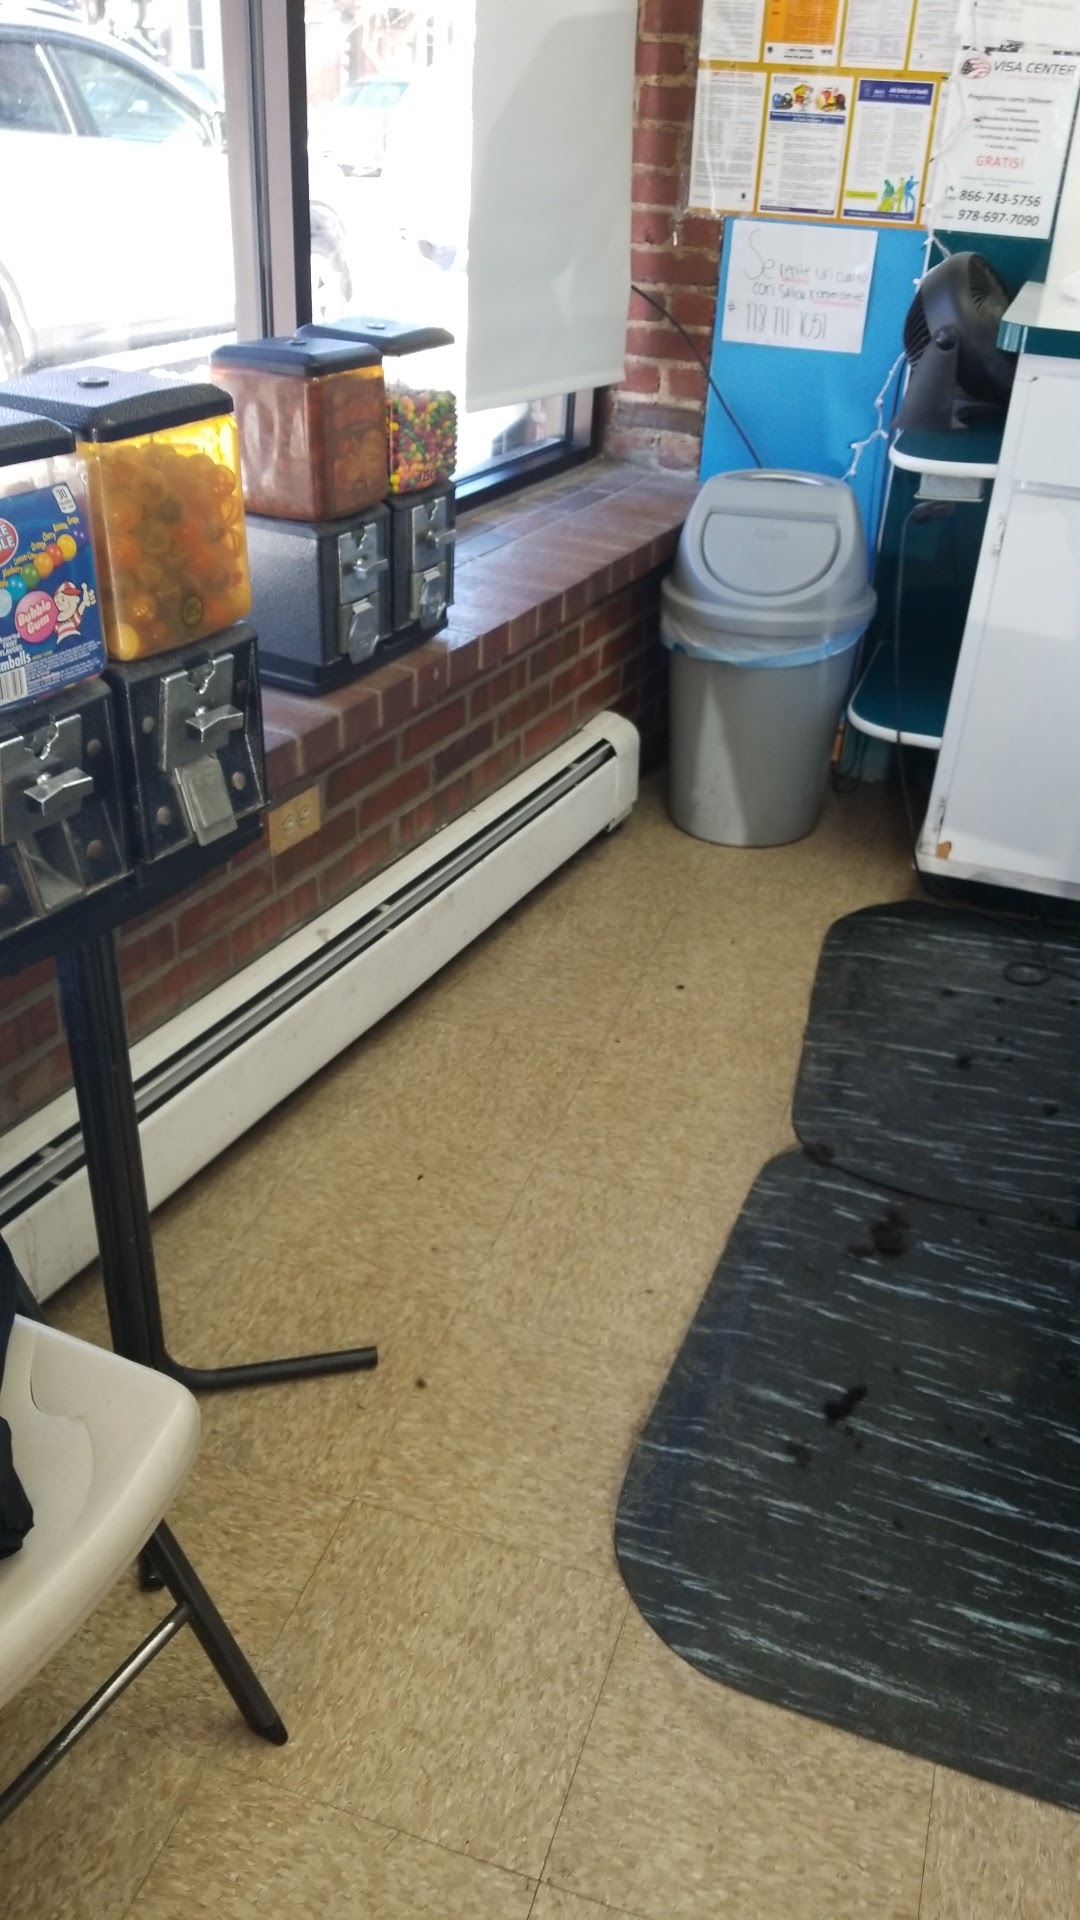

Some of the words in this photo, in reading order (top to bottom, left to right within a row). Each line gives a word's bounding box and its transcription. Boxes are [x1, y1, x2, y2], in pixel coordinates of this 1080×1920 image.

[993, 60, 1022, 73] VISA
[1025, 62, 1077, 76] CENTER
[976, 155, 1024, 169] GRATIS!
[959, 190, 1042, 207] 866-743-5756
[957, 209, 1040, 227] 978-697-7090
[57, 488, 68, 500] 30
[17, 600, 52, 627] Bubble
[27, 614, 50, 635] Gum
[0, 650, 31, 673] mballs
